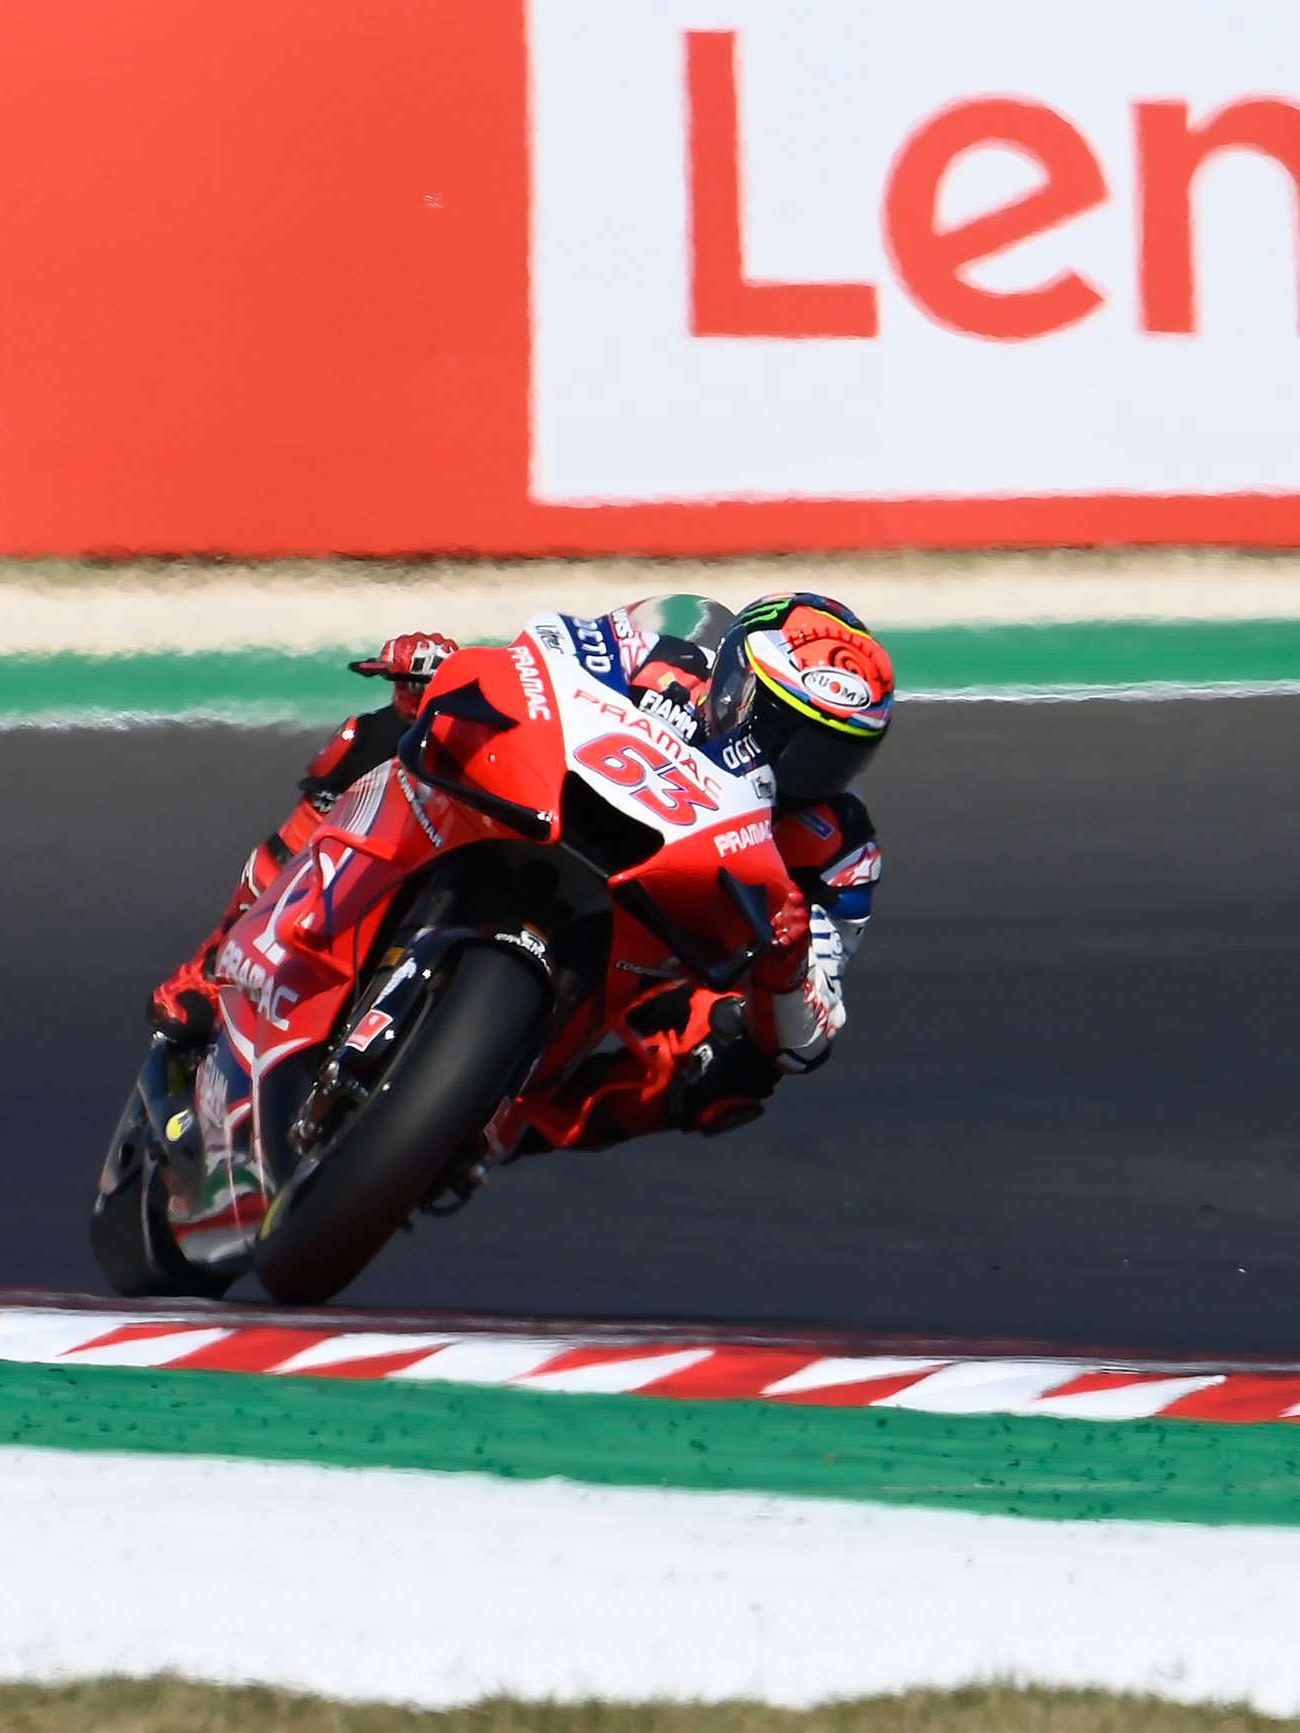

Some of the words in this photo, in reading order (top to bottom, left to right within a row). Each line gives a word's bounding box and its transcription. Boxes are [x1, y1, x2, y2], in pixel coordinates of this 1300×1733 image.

[683, 29, 1300, 344] Len
[508, 646, 552, 721] PRAMAC
[638, 688, 699, 741] FIAMM
[573, 688, 724, 801] PRAMAC
[573, 732, 720, 827] 63
